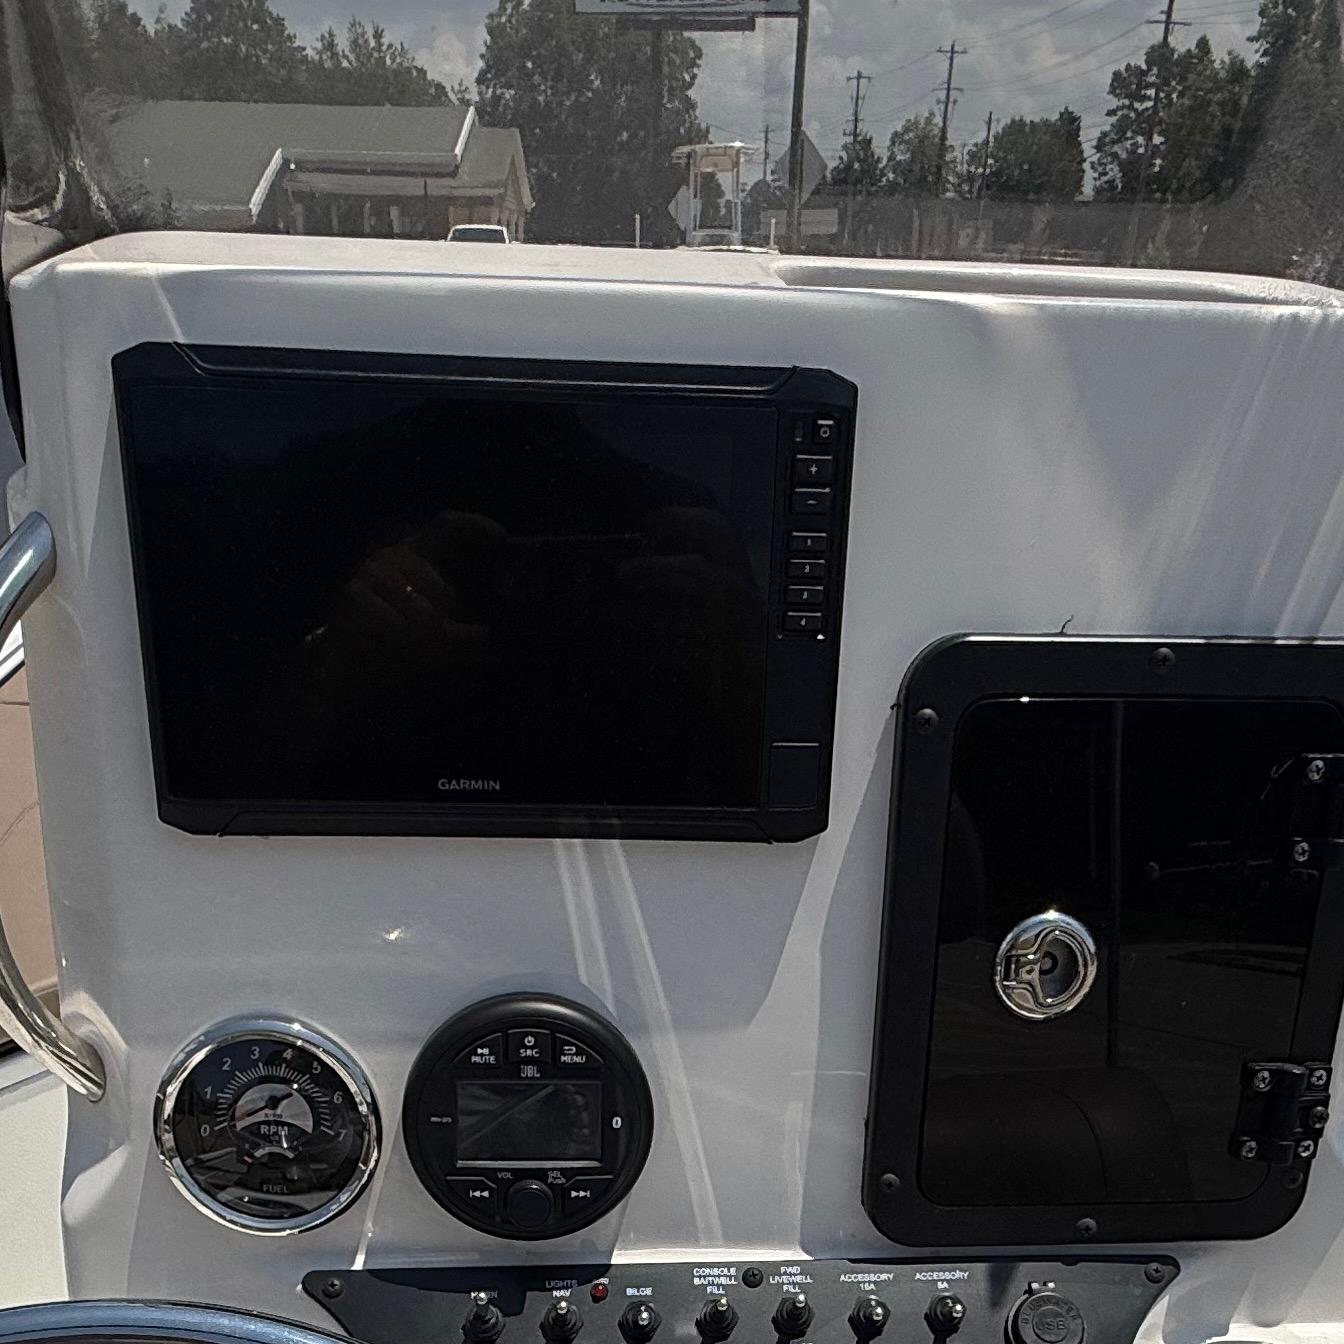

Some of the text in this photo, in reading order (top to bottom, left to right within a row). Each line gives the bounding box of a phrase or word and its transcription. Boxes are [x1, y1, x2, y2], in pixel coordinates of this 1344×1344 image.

[438, 779, 501, 791] GARMIN
[250, 1046, 260, 1059] 3
[283, 1048, 293, 1060] 4
[520, 1048, 540, 1057] SRC
[222, 1057, 232, 1071] 2
[471, 1055, 496, 1064] MUTE
[560, 1055, 586, 1064] MENU
[312, 1060, 321, 1074] 5
[520, 1065, 541, 1077] JBL
[204, 1086, 212, 1099] 1
[333, 1091, 343, 1104] 6
[201, 1124, 211, 1137] 0
[260, 1125, 289, 1135] RPM
[338, 1129, 347, 1142] 7
[263, 1184, 289, 1193] FUEL
[693, 1267, 737, 1276] CONSOLE
[781, 1266, 801, 1274] FWD
[769, 1275, 813, 1284] LIVEWELL
[839, 1273, 894, 1283] ACCESSORY
[915, 1271, 969, 1280] ACCESSORY
[545, 1280, 578, 1289] LIGHTS
[693, 1276, 738, 1285] BAITWELL
[626, 1287, 653, 1296] BILGE
[706, 1286, 725, 1294] FILL
[782, 1284, 801, 1293] FILL
[552, 1289, 571, 1298] NAV
[1035, 1319, 1066, 1331] USB
